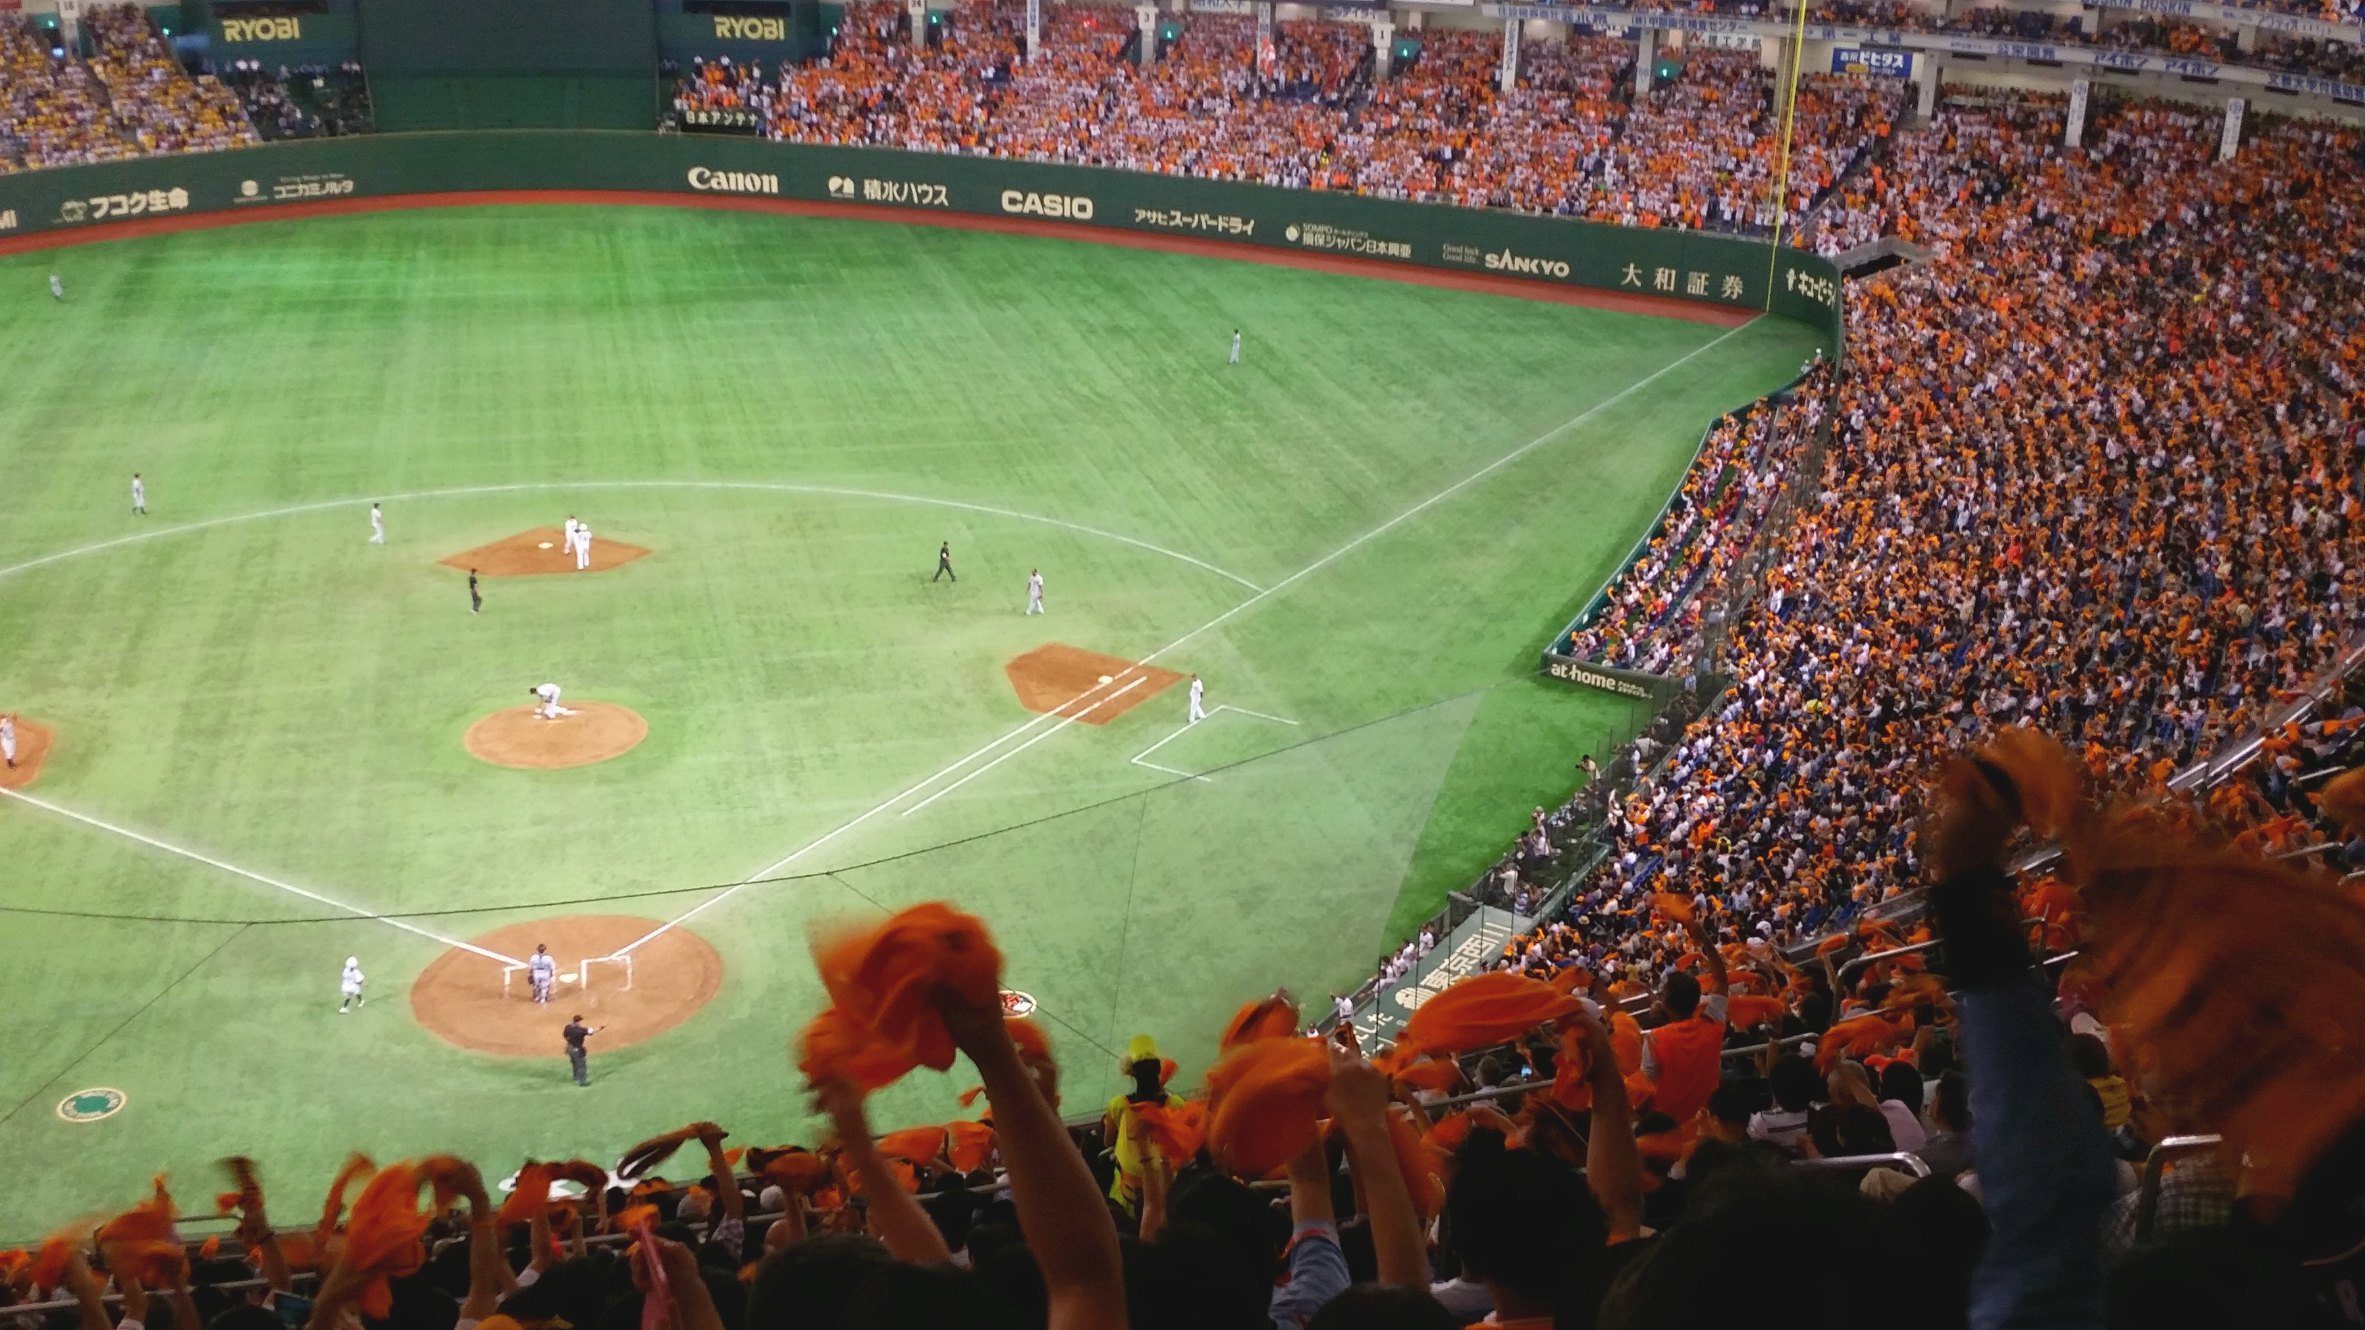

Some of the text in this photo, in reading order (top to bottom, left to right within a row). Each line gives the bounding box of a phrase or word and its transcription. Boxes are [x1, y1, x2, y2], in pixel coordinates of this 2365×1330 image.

[222, 17, 300, 42] RYOBI
[714, 16, 785, 41] RYOBI
[685, 110, 759, 127] 日本アンテナ
[687, 166, 779, 194] Canon
[863, 179, 949, 207] 積水ハウス
[1001, 189, 1094, 220] CASIO
[1484, 247, 1570, 278] SANKYO
[1620, 262, 1745, 301] 大和証券
